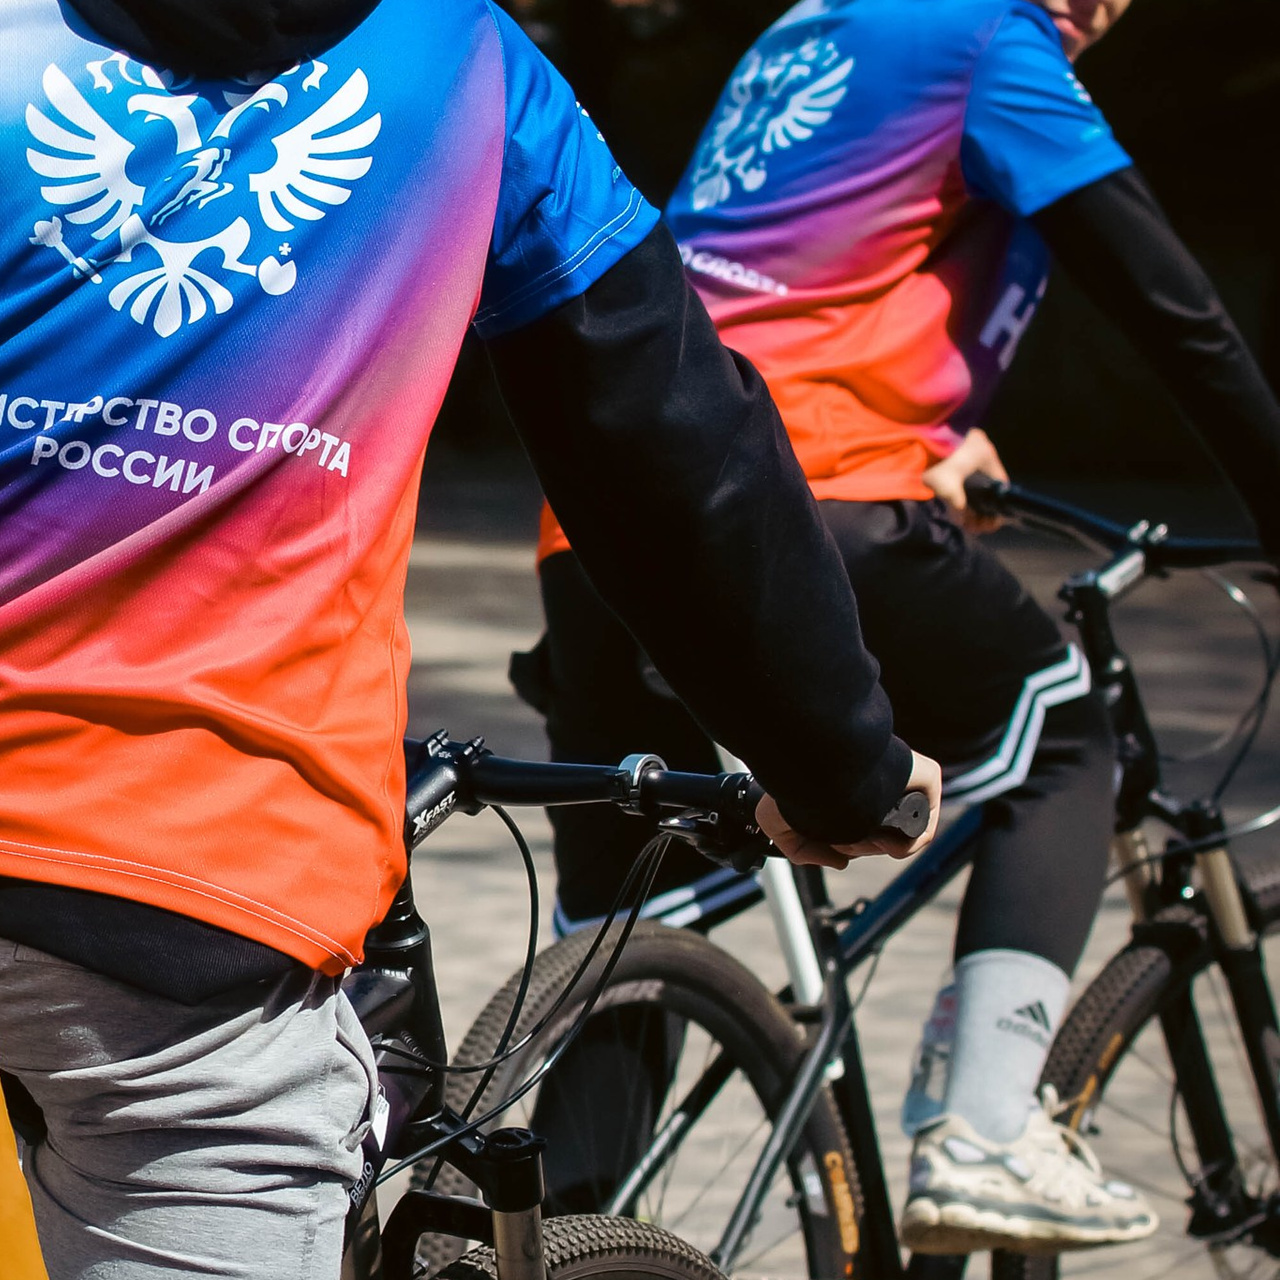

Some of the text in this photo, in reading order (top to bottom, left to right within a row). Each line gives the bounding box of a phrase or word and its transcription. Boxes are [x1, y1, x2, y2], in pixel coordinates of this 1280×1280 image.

[30, 435, 215, 495] РОССИИ
[228, 417, 351, 478] СПОРТА
[412, 790, 456, 837] XFAST
